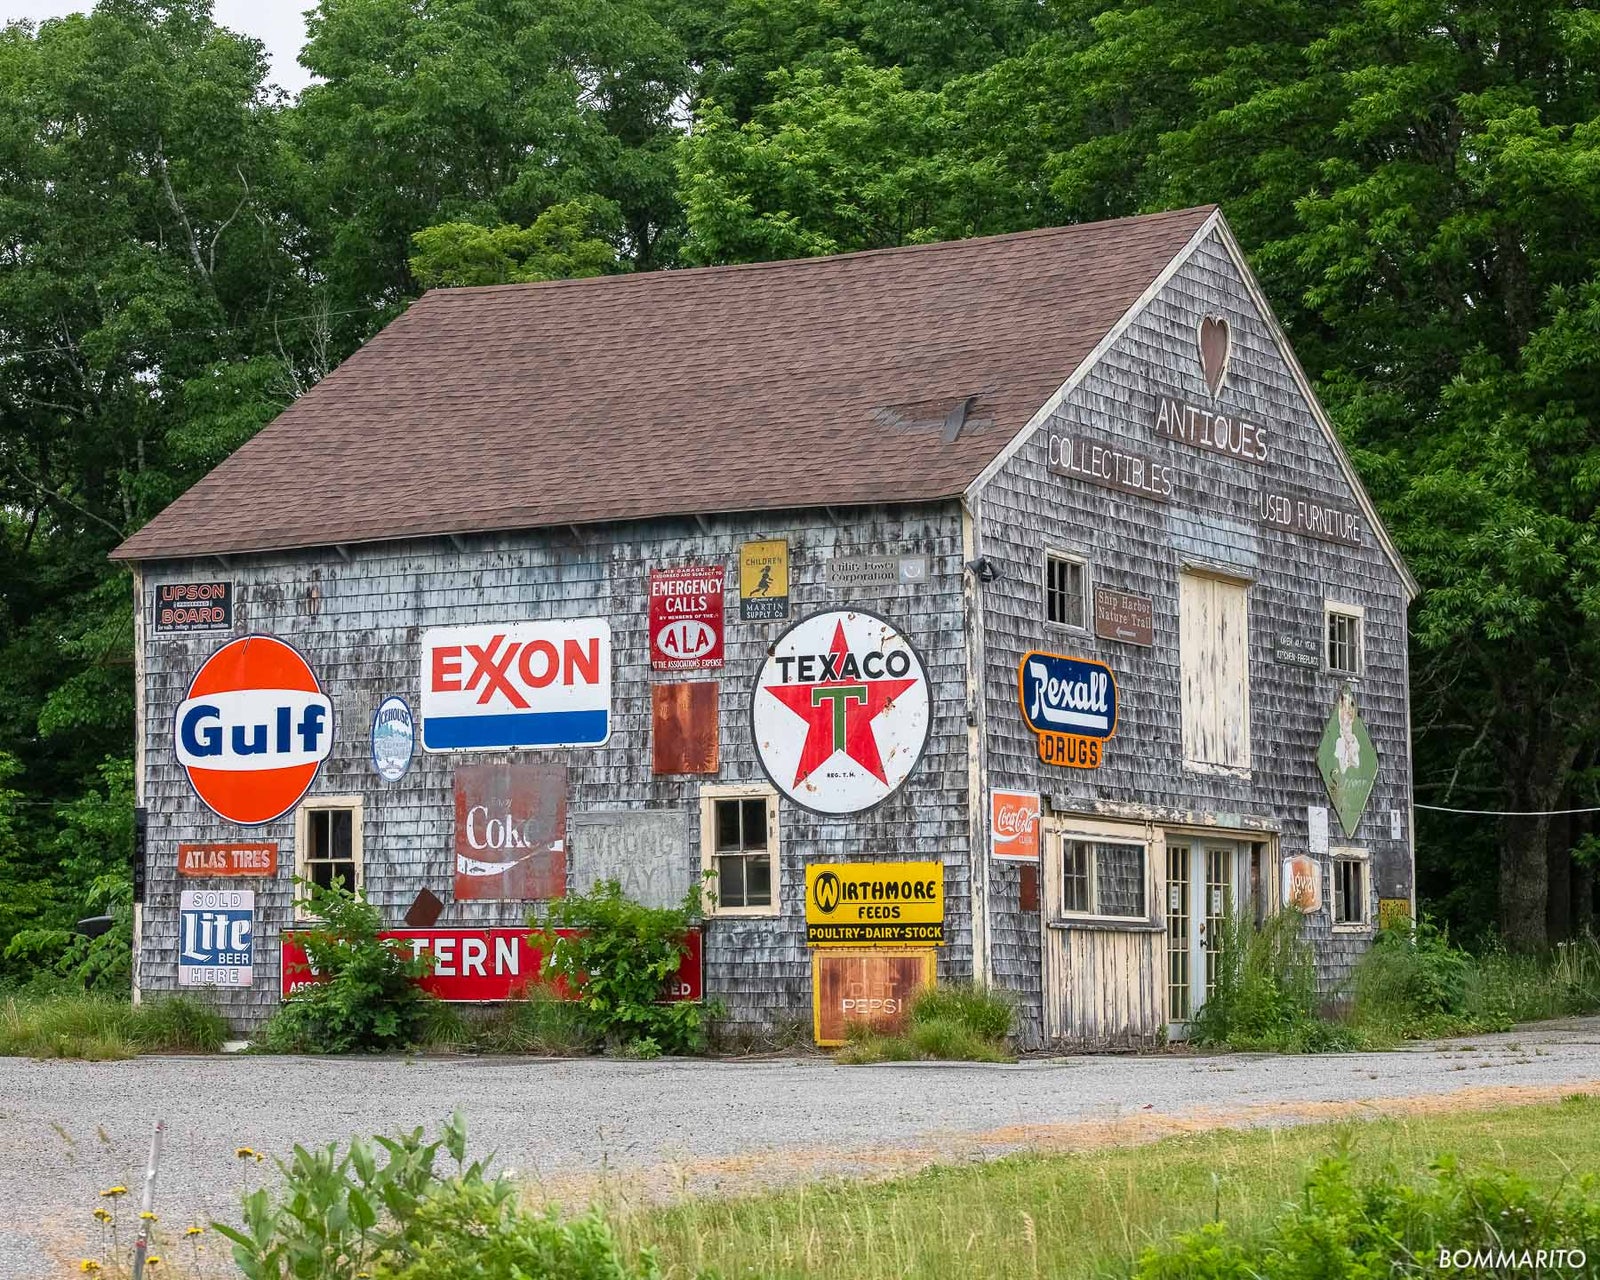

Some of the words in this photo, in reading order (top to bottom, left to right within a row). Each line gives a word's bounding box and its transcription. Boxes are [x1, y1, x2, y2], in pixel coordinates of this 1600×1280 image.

[1155, 398, 1268, 462] ANTIQUES
[1048, 433, 1172, 497] COLLECTIBLES
[1260, 491, 1291, 526] USED
[1297, 501, 1361, 543] FURNITURE
[831, 572, 894, 583] Corporation
[162, 583, 225, 601] UPSON
[652, 578, 723, 597] EMERGENCY
[665, 595, 708, 613] CALLS
[746, 603, 783, 611] MARTIN
[1098, 590, 1118, 608] Ship
[1121, 595, 1151, 613] Harbor
[161, 606, 225, 624] BOARD
[1098, 606, 1129, 625] Nature
[1131, 614, 1151, 629] Trail
[664, 625, 710, 653] ALA
[431, 634, 599, 709] EXXON
[701, 658, 723, 667] EXPENSE
[775, 650, 911, 683] TEXACO
[1029, 660, 1108, 729] Rexall
[377, 708, 410, 728] ICEHOUSE
[180, 704, 326, 758] Gulf
[1044, 735, 1099, 766] DRUGS
[232, 849, 271, 868] TIRES
[192, 892, 242, 908] SOLD
[858, 905, 901, 919] FEEDS
[181, 912, 252, 962] Lite
[809, 926, 942, 939] POULTRY-DAIRY-STOCK
[218, 952, 249, 964] BEER
[191, 968, 239, 983] HERE
[842, 998, 902, 1014] PEPSI
